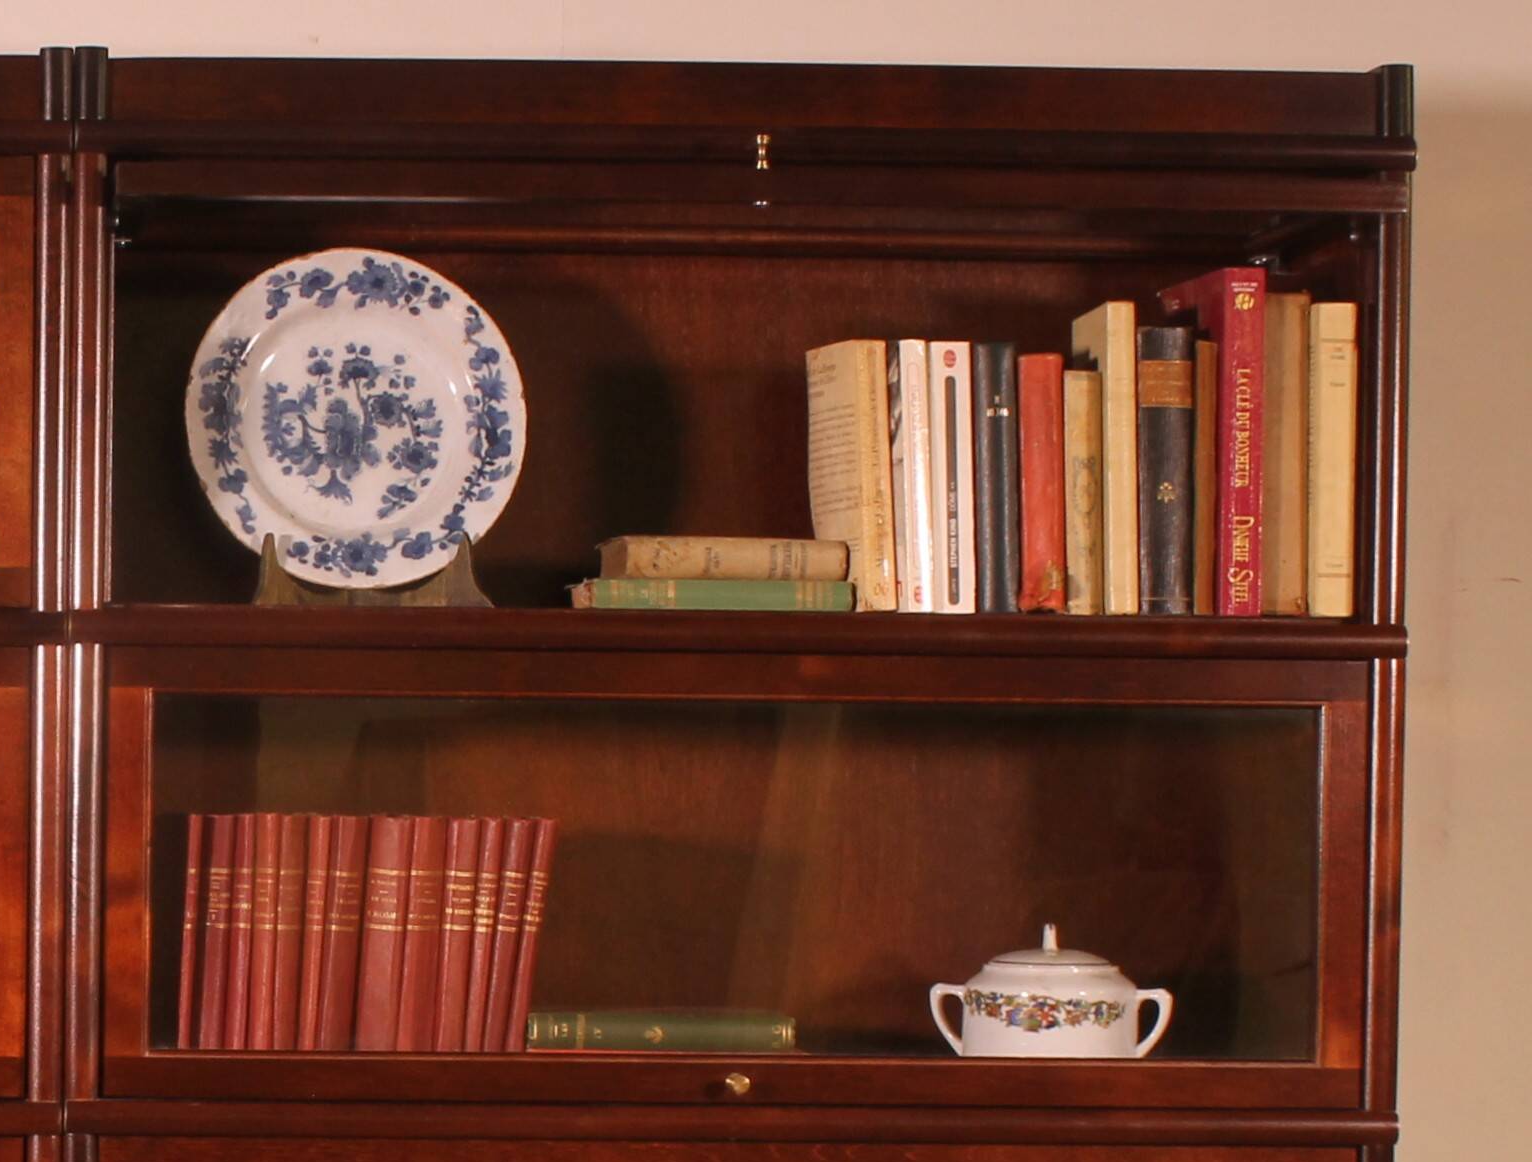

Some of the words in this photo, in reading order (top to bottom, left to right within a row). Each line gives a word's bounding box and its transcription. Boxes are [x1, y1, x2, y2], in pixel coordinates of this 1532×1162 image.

[1236, 368, 1251, 384] LA
[1235, 386, 1253, 409] CLÉ
[1235, 412, 1251, 429] DU
[1234, 431, 1250, 488] BONHEUR
[948, 518, 958, 536] KING
[948, 536, 958, 568] STEPHEN
[1227, 566, 1254, 603] STEEL
